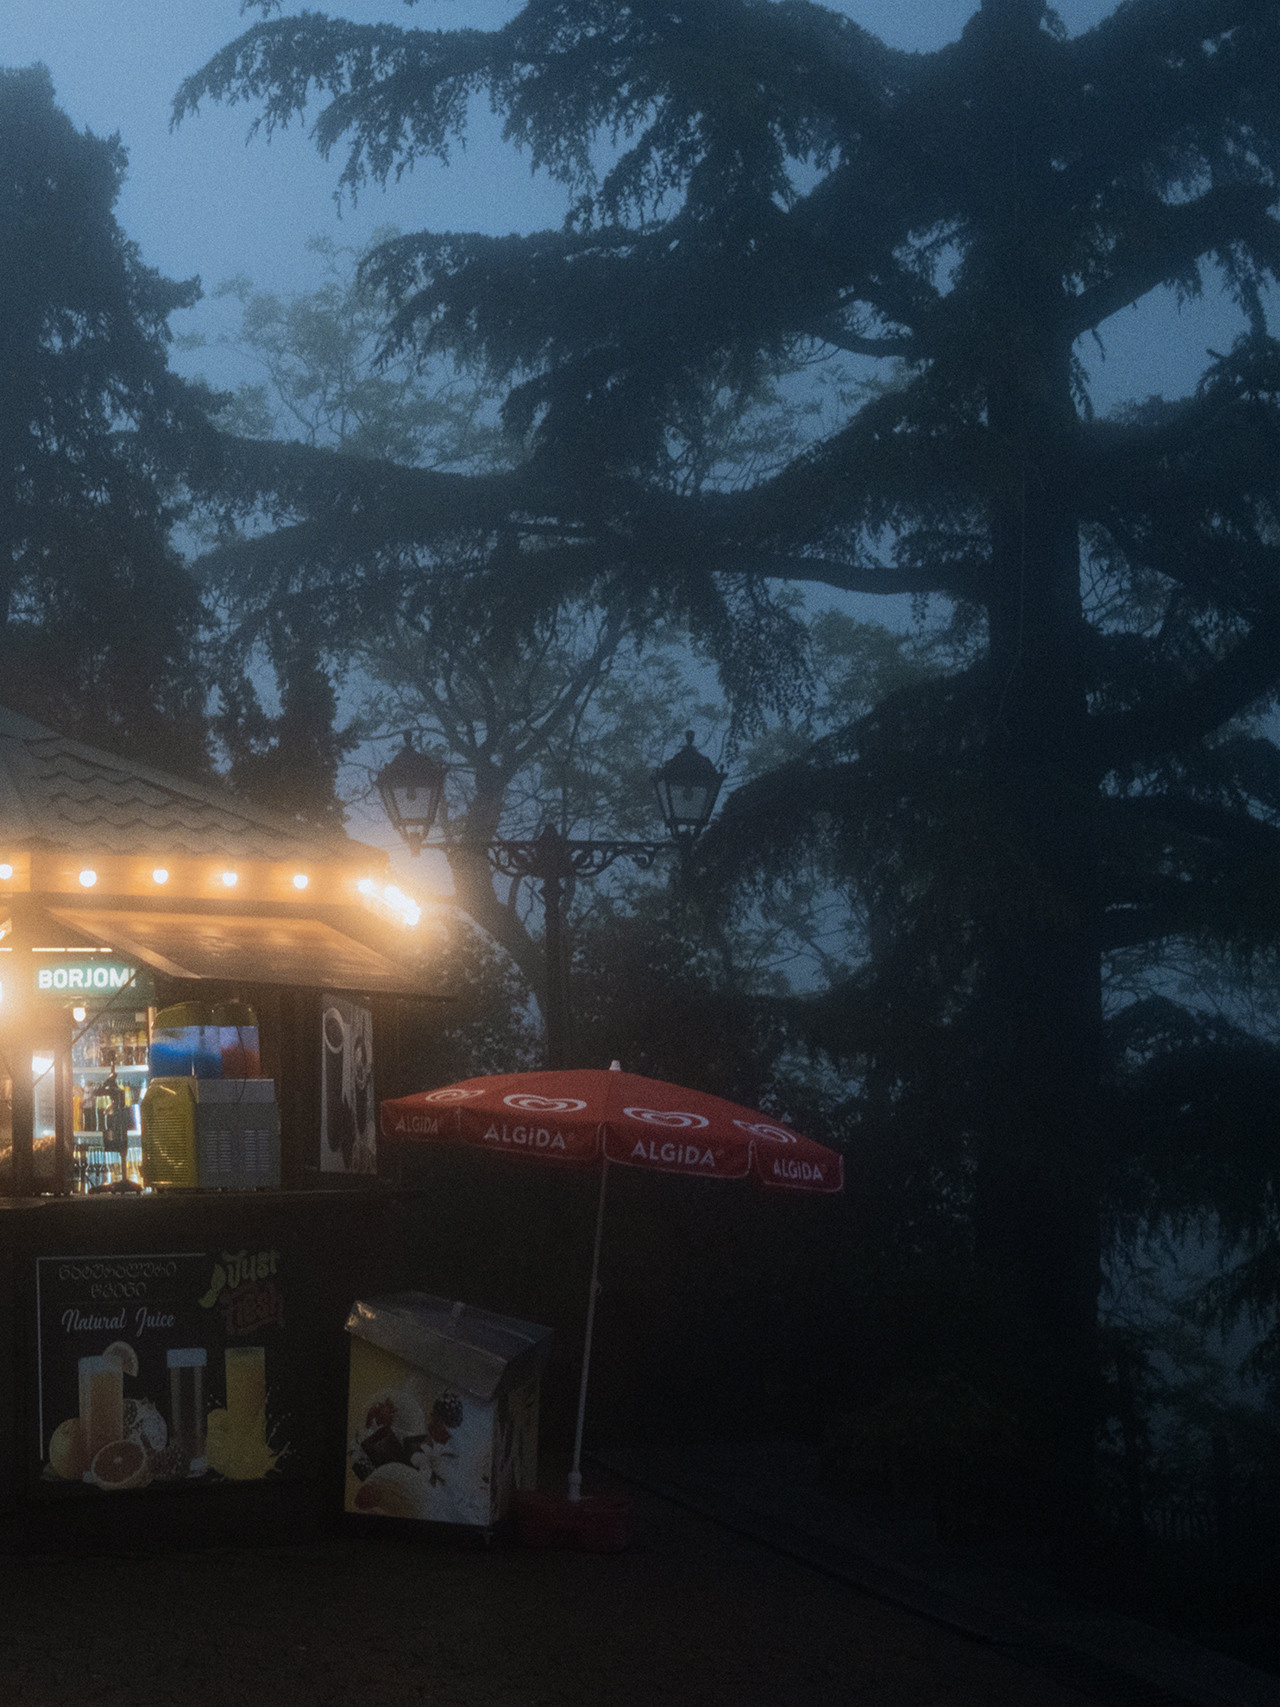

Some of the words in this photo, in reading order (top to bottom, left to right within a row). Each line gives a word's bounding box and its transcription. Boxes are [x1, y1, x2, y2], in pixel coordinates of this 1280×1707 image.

[38, 967, 136, 989] BORJOMI
[61, 1306, 127, 1334] Natural
[135, 1306, 176, 1338] Juice
